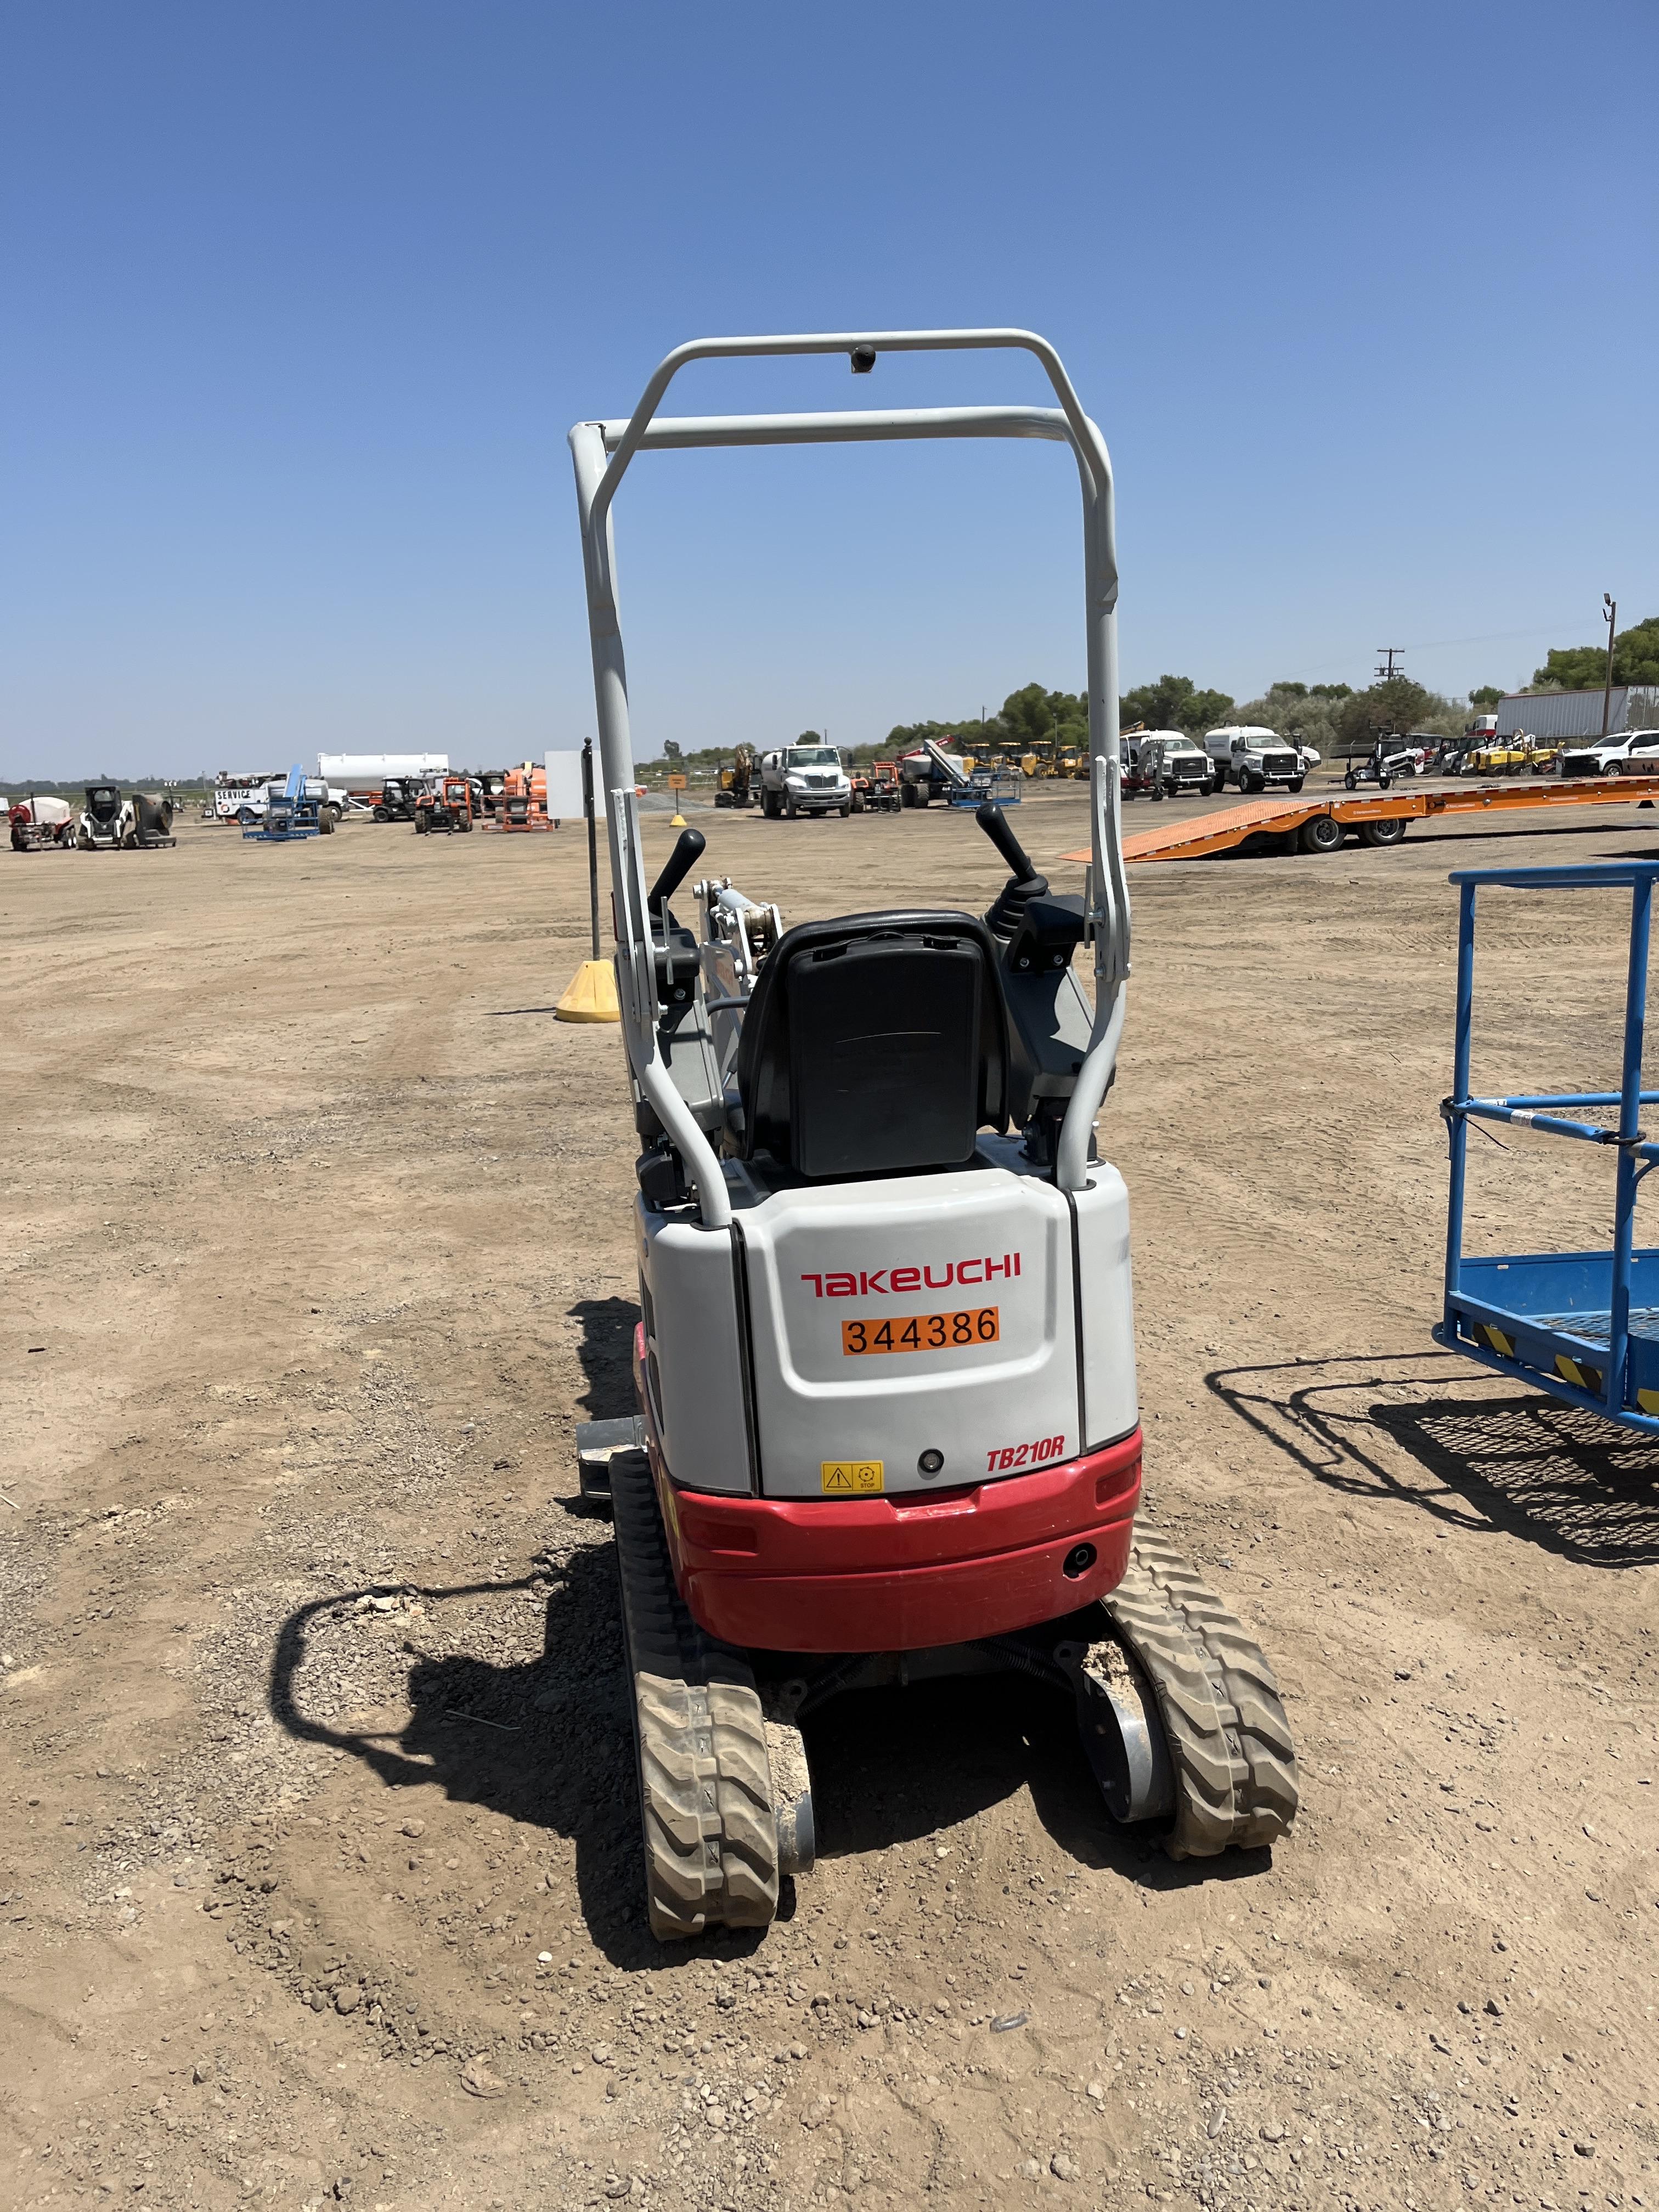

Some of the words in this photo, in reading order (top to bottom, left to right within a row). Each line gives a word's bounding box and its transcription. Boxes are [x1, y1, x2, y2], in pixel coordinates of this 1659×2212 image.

[217, 790, 251, 799] SERVICE
[847, 1309, 995, 1353] 344386
[987, 1435, 1065, 1472] TB210R
